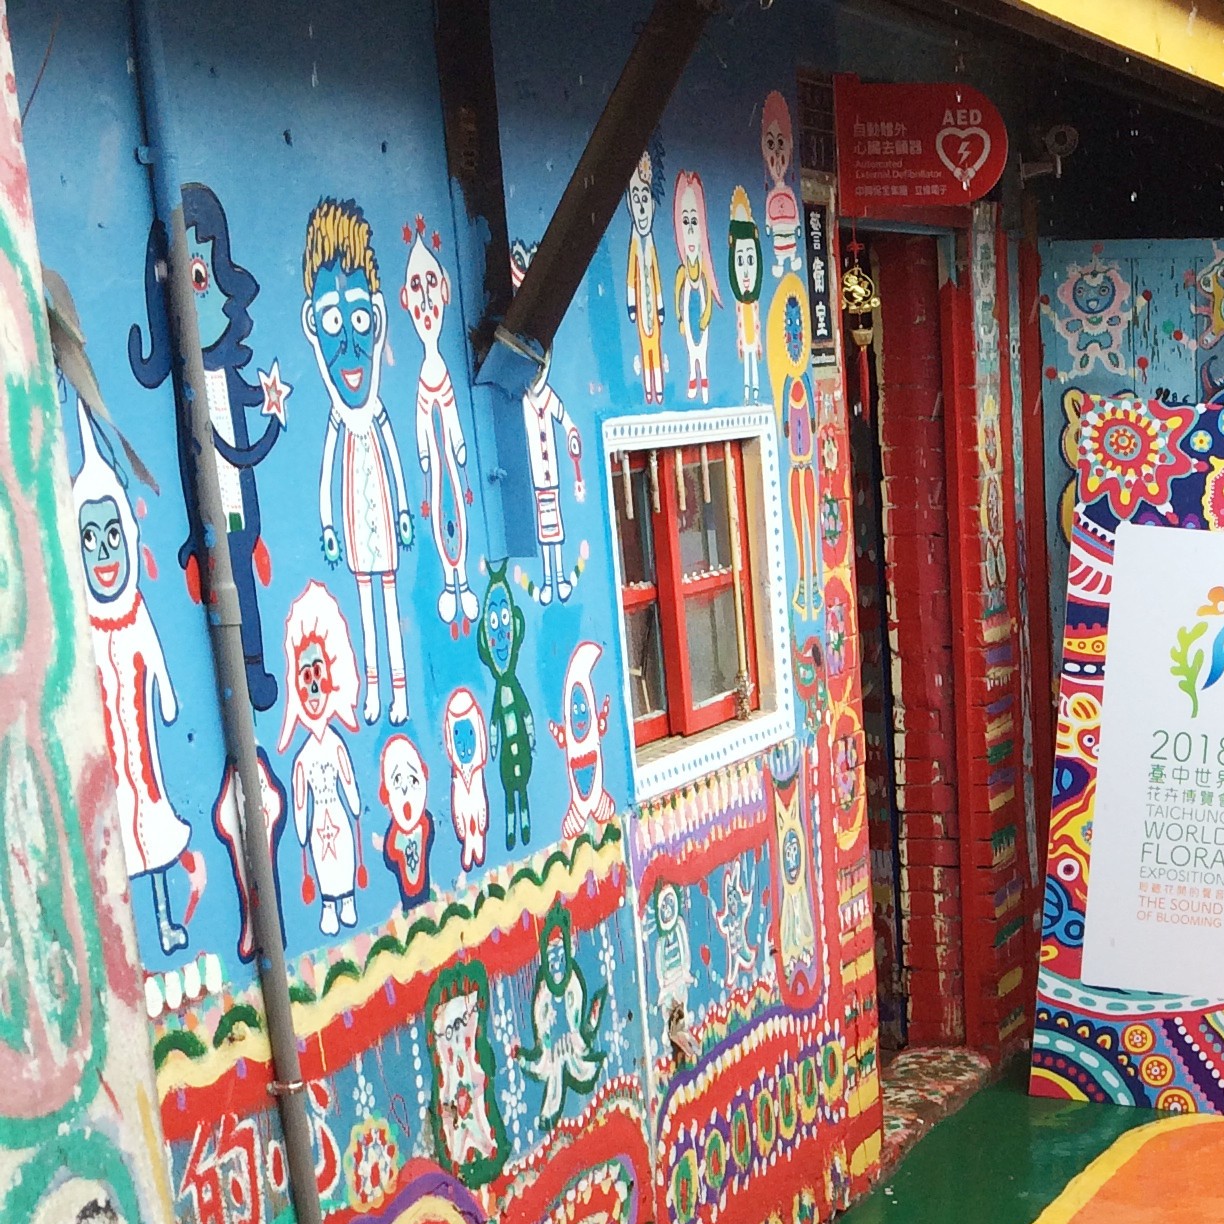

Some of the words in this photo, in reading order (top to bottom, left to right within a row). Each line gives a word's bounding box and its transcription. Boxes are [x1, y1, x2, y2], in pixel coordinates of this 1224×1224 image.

[942, 109, 982, 126] AED
[1138, 895, 1166, 910] THE
[1170, 898, 1224, 915] SOUND
[1136, 910, 1153, 921] OF
[1156, 912, 1222, 928] BLOOMING
